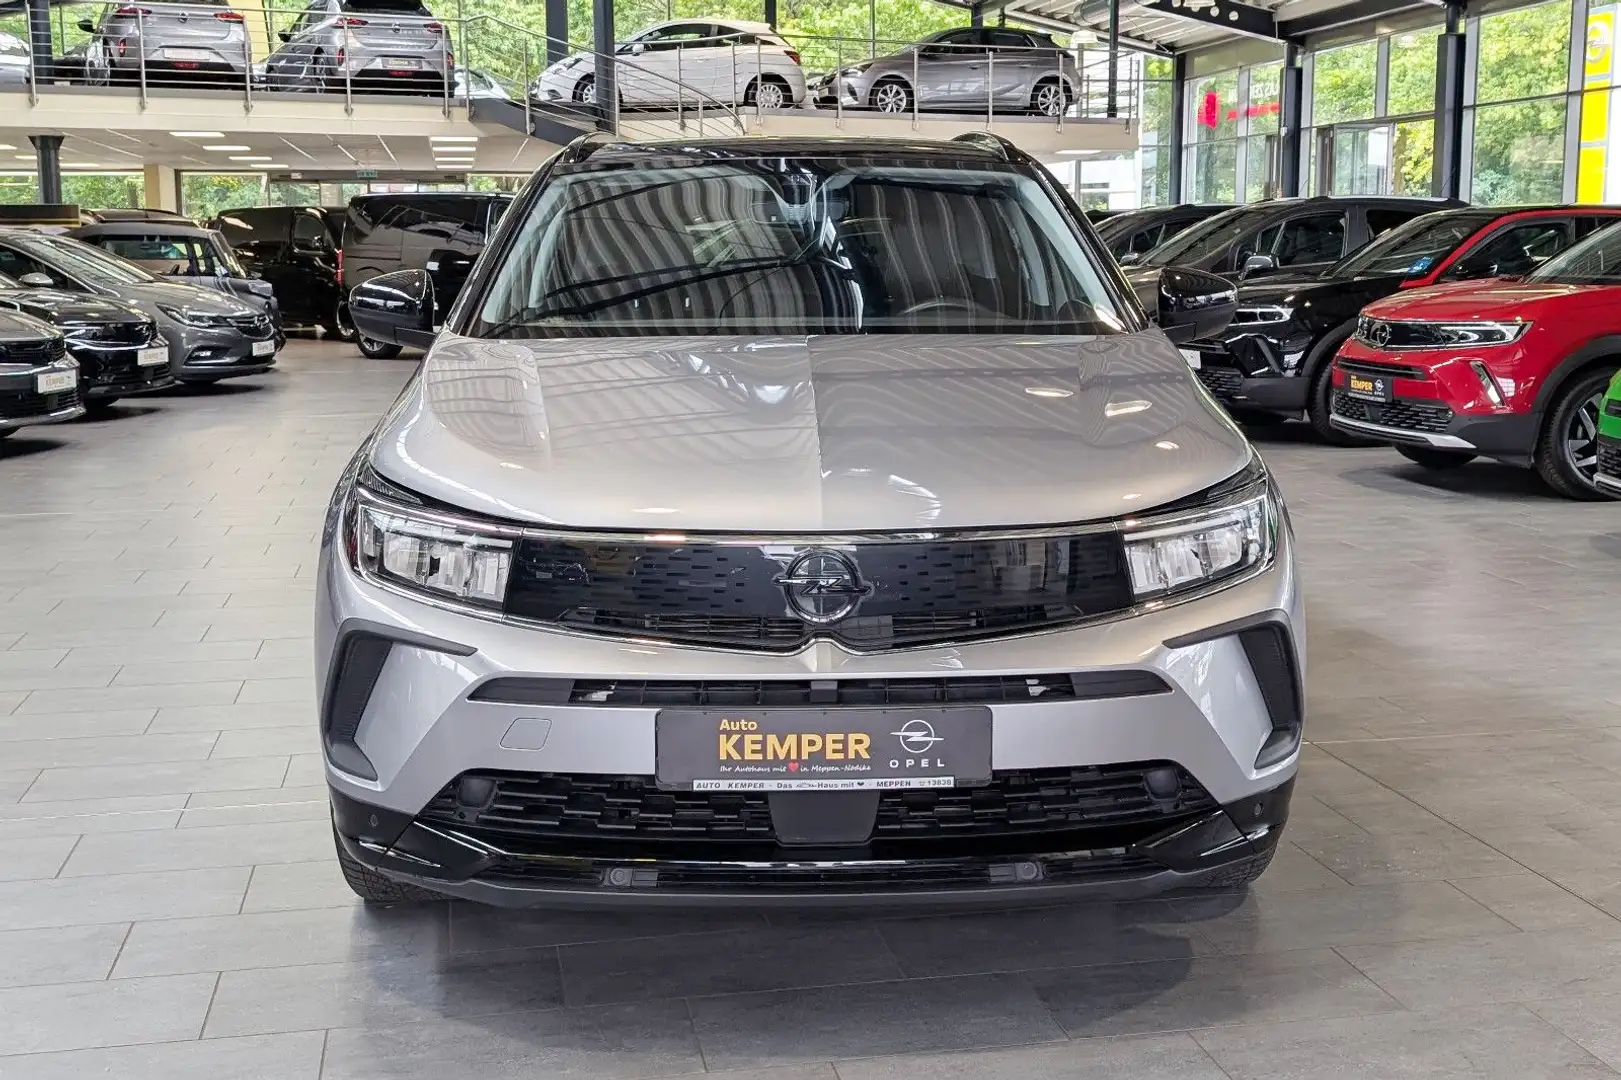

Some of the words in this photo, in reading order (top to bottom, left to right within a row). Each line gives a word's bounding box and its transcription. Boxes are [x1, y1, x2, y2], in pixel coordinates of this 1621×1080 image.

[719, 718, 758, 731] Auto
[719, 733, 871, 760] KEMPER
[889, 758, 945, 768] OPEL
[735, 765, 771, 773] Autohaus
[840, 781, 855, 789] mit
